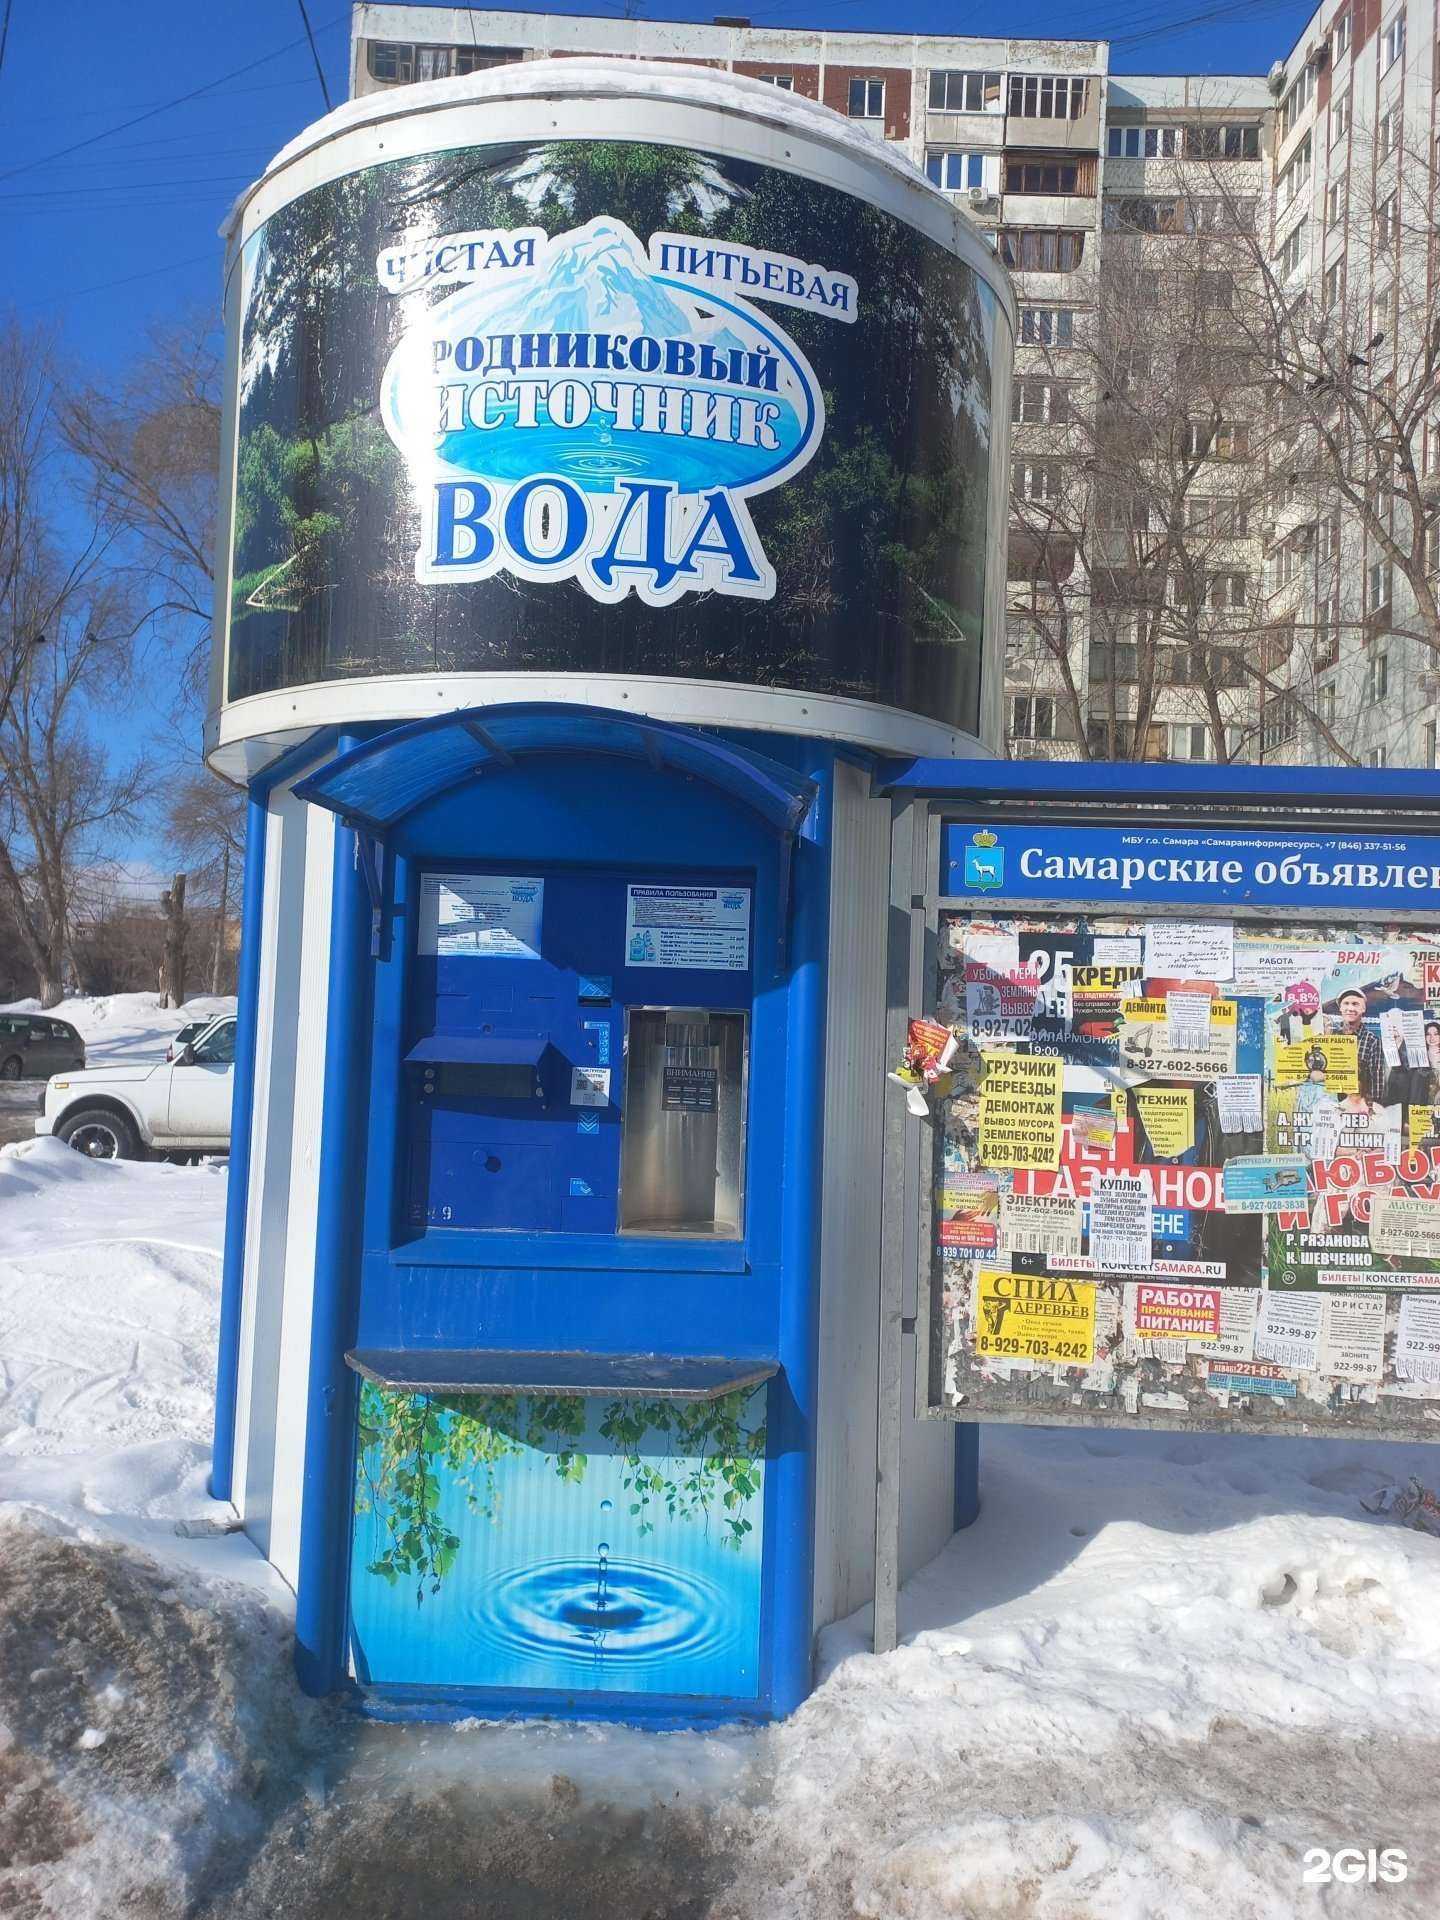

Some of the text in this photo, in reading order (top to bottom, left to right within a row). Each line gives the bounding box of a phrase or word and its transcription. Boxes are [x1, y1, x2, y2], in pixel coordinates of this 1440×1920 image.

[660, 243, 850, 312] ПИТЬЕВАЯ
[432, 333, 780, 393] РОДНИКОВЫЙ
[435, 379, 782, 451] ИСТОЧНИК
[430, 477, 762, 591] ВОДА
[1122, 836, 1143, 845] МБУ
[1145, 837, 1161, 846] г.о.
[1163, 837, 1199, 848] Самара
[1201, 838, 1323, 851] «Самараинформресурс»,
[1338, 841, 1362, 851] (846)
[1364, 842, 1407, 852] 337-51-56
[1020, 848, 1243, 890] Самарские
[633, 889, 664, 897] ПРАВИЛА
[665, 890, 714, 898] ПОЛЬЗОВАНИЯ
[1259, 957, 1294, 966] РАБОТА
[973, 968, 1010, 980] УБОРКА
[1287, 991, 1320, 1003] 8,8%
[1028, 1042, 1059, 1056] 19:00
[986, 1060, 1056, 1077] ГРУЗЧИКИ
[1126, 1059, 1228, 1073] 8-927-602-5666
[986, 1080, 1056, 1097] ПЕРЕЕЗДЫ
[1116, 1094, 1188, 1106] СТЕХНИК
[985, 1100, 1055, 1115] ДЕМОНТАЖ
[984, 1117, 1055, 1129] ВЫВОЗ МУСОРА
[1277, 1112, 1291, 1127] А.
[1293, 1112, 1369, 1128] ЖУЛЕВ
[984, 1129, 1055, 1143] ЗЕМЛЕКОПЫ
[1278, 1131, 1291, 1146] Н.
[982, 1144, 1055, 1164] 8-929-703-4242
[1100, 1179, 1142, 1191] КУПЛЮ
[1006, 1195, 1077, 1209] ЭЛЕКТРИК
[1241, 1200, 1305, 1210] 8-927-028-3838
[1006, 1206, 1075, 1216] 8-927-602-5666
[1286, 1234, 1370, 1248] Р. РЯЗАНОВА
[943, 1247, 958, 1257] 939
[959, 1248, 973, 1258] 701
[974, 1249, 985, 1259] 00
[986, 1249, 996, 1260] 44
[1286, 1252, 1373, 1266] К. ШЕВЧЕНКО
[1021, 1257, 1034, 1265] 6+
[1051, 1257, 1096, 1269] БИЛЕТЫ
[1321, 1273, 1361, 1282] БИЛЕТЫ
[993, 1277, 1078, 1302] СПИЛ
[1141, 1289, 1215, 1309] РАБОТА
[1013, 1302, 1089, 1318] ДЕРЕВЬЕВ
[1141, 1306, 1215, 1320] ПРОЖИВАНИЕ
[1140, 1315, 1215, 1333] ПИТАНИЕ
[1267, 1325, 1317, 1340] 922-99-87
[980, 1336, 1088, 1358] 8-929-703-4242
[1200, 1342, 1244, 1354] 922-99-87
[1341, 1352, 1369, 1360] ЗВОНИТЕ
[1333, 1362, 1378, 1373] 922-99-87
